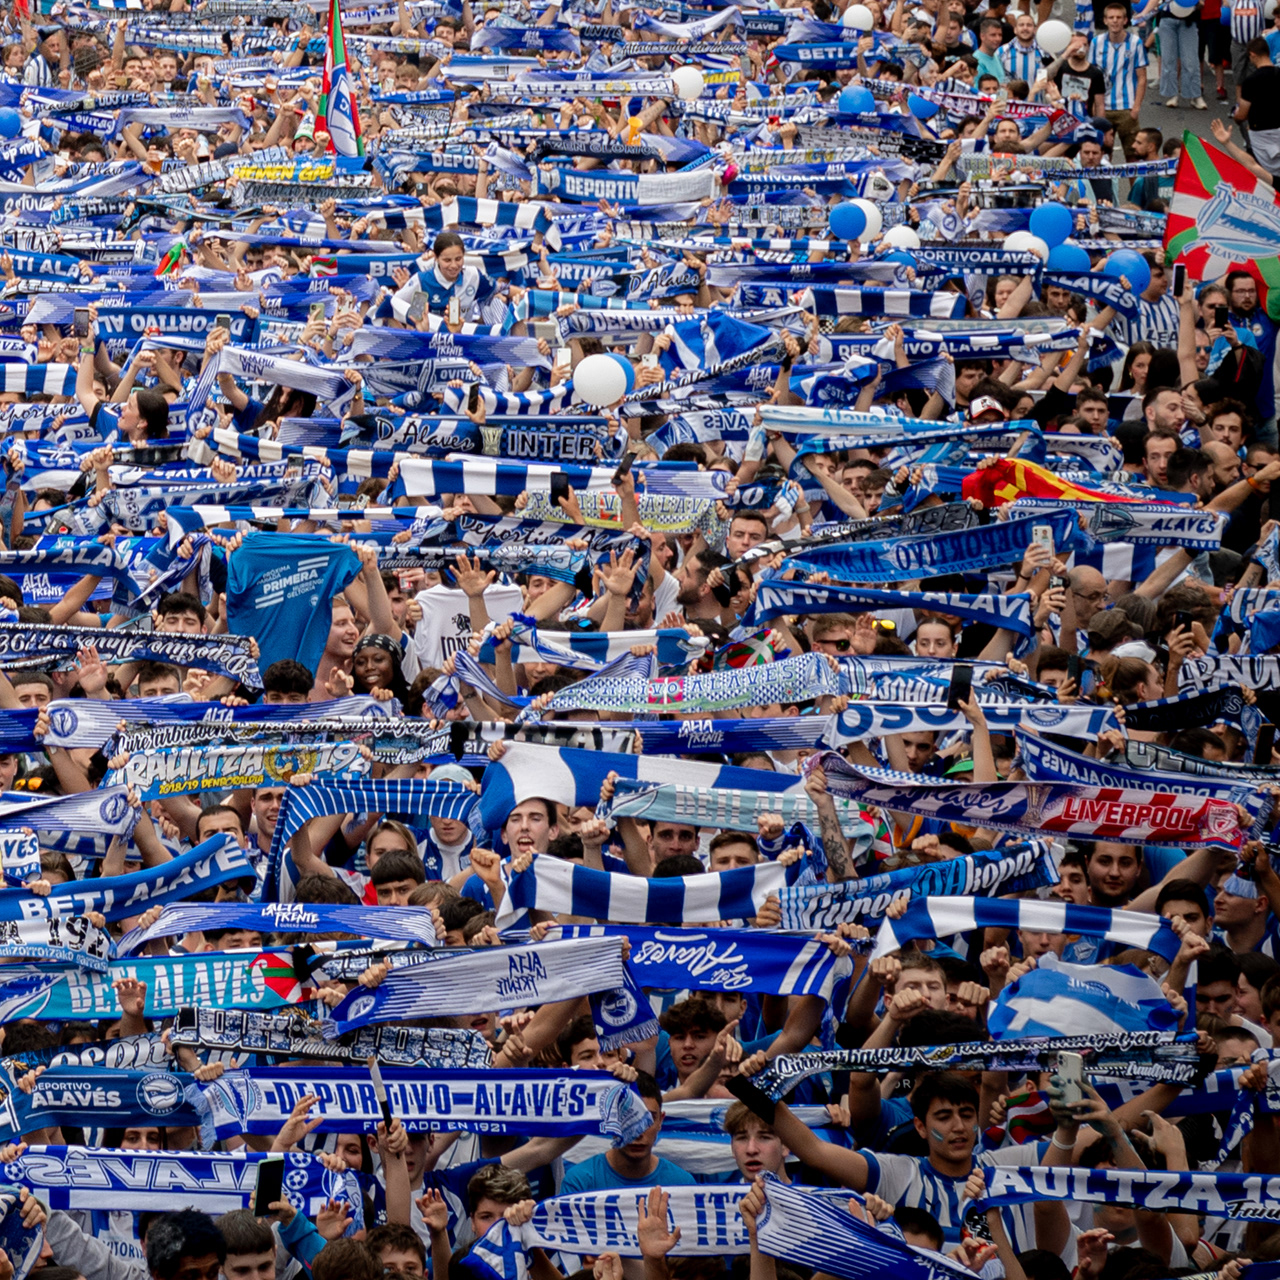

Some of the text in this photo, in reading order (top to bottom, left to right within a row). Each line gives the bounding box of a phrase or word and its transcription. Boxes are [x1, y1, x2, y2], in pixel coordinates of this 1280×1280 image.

[508, 429, 595, 457] INTER
[23, 574, 50, 590] ALTA
[263, 572, 318, 593] PRIMERA
[1062, 796, 1196, 830] LIVERPOOL
[18, 895, 113, 919] BETI
[266, 904, 302, 916] ALTA
[275, 907, 319, 923] FRENTE
[152, 958, 265, 1009] ALAVES
[33, 1082, 91, 1092] DEPORTIVO
[34, 1089, 121, 1107] ALAVÉS
[474, 1078, 587, 1116] ALAVÉS
[446, 1122, 467, 1131] EN
[474, 1122, 506, 1132] 1921
